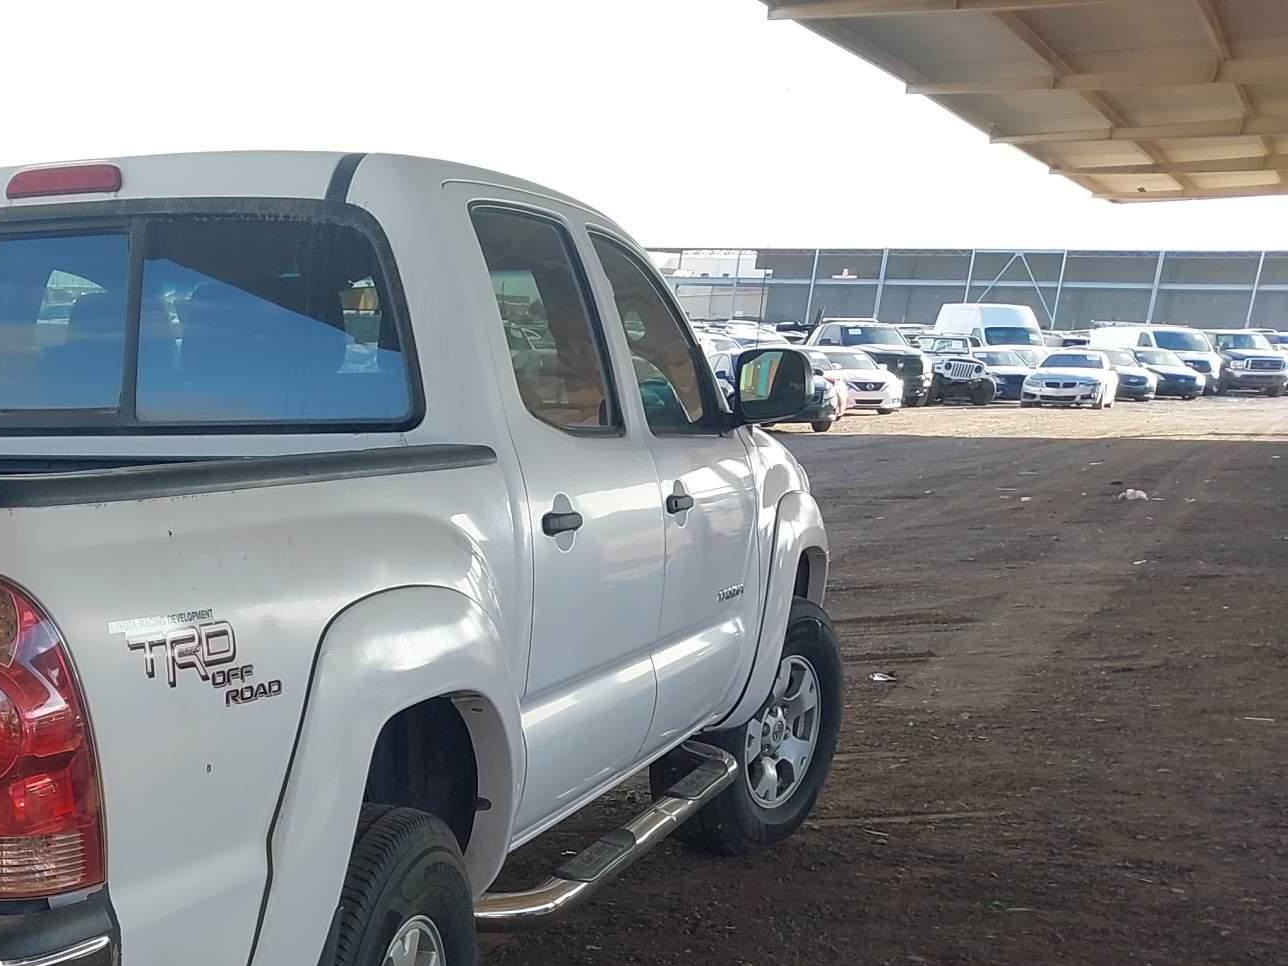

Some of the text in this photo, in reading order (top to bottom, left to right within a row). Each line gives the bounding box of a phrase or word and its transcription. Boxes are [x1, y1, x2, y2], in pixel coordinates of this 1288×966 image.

[167, 609, 213, 625] DEVELOPMENT
[126, 621, 236, 688] TRD
[211, 664, 254, 688] OFF
[226, 679, 283, 706] ROAD
